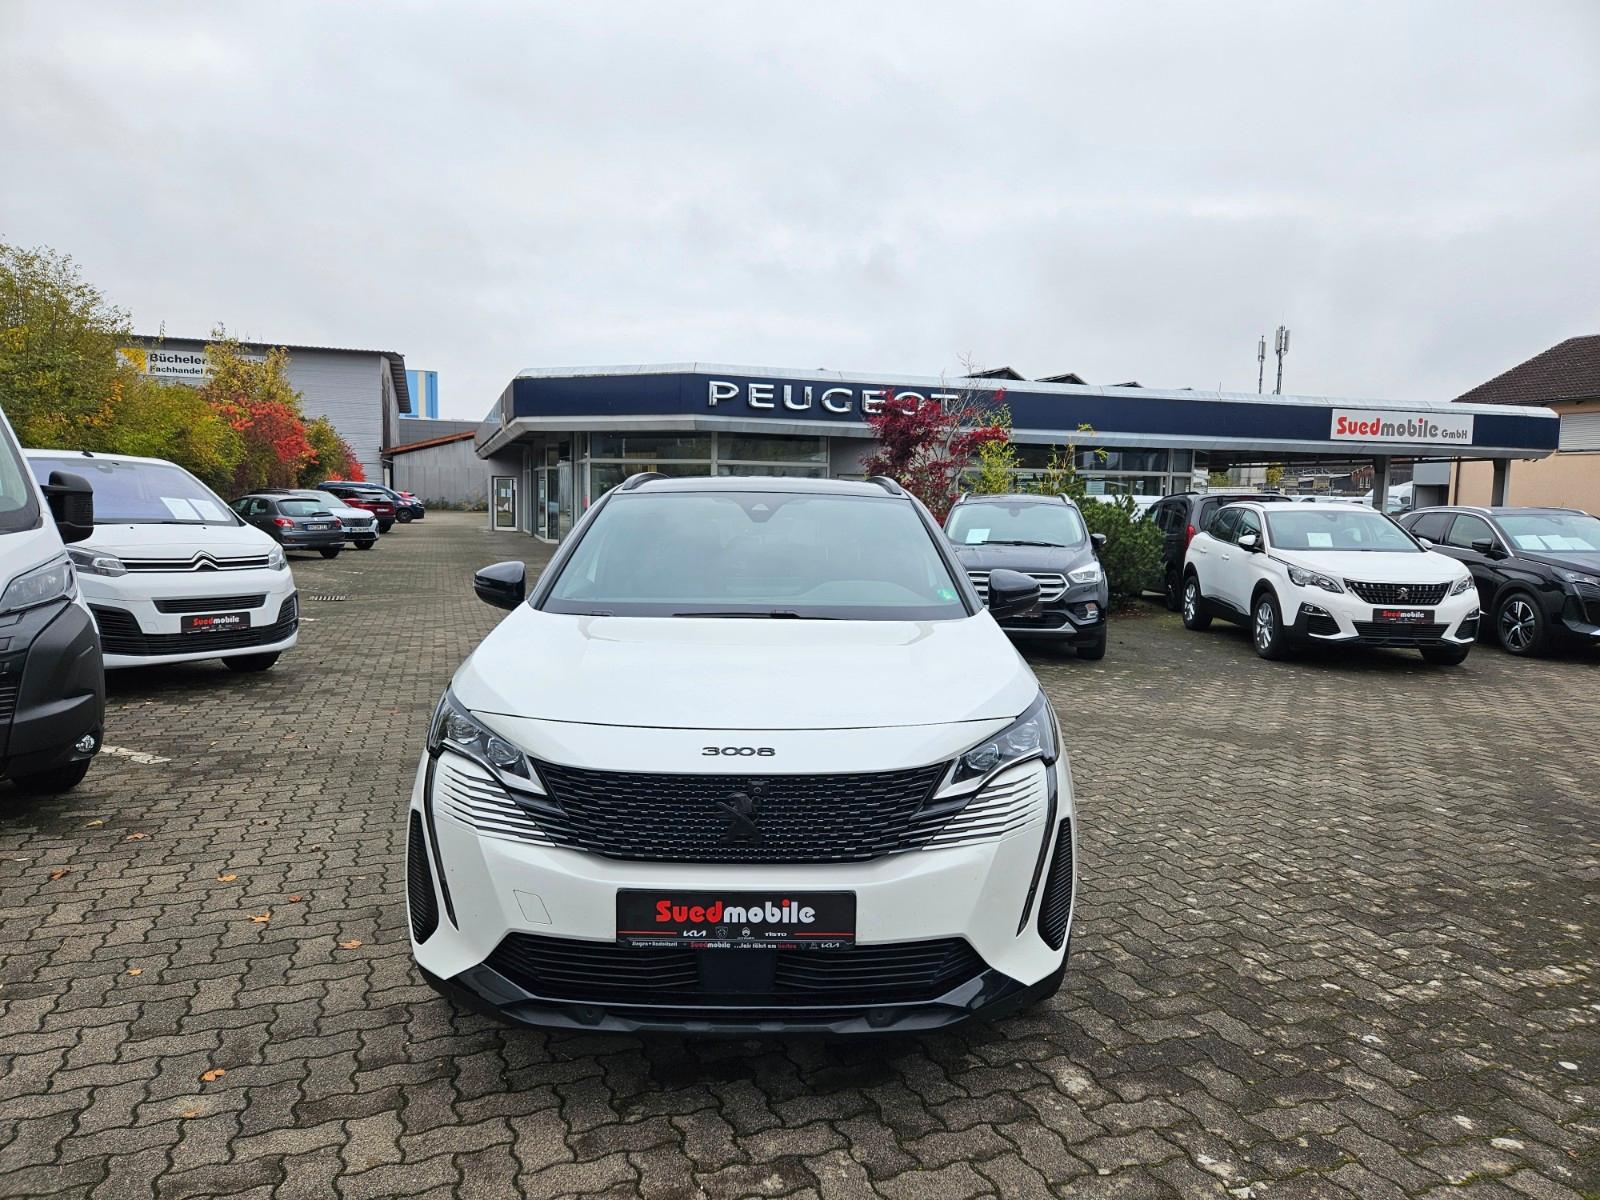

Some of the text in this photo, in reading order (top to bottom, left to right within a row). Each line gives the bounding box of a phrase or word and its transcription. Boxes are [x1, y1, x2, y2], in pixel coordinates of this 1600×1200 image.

[150, 353, 207, 365] Bücheler
[150, 365, 203, 374] Fachhandel
[1336, 416, 1467, 439] Suedmobile GmbH
[1382, 610, 1425, 618] Suedmobile
[192, 616, 240, 626] Suedmobile
[701, 746, 775, 757] 3008
[655, 899, 816, 924] Suedmobile
